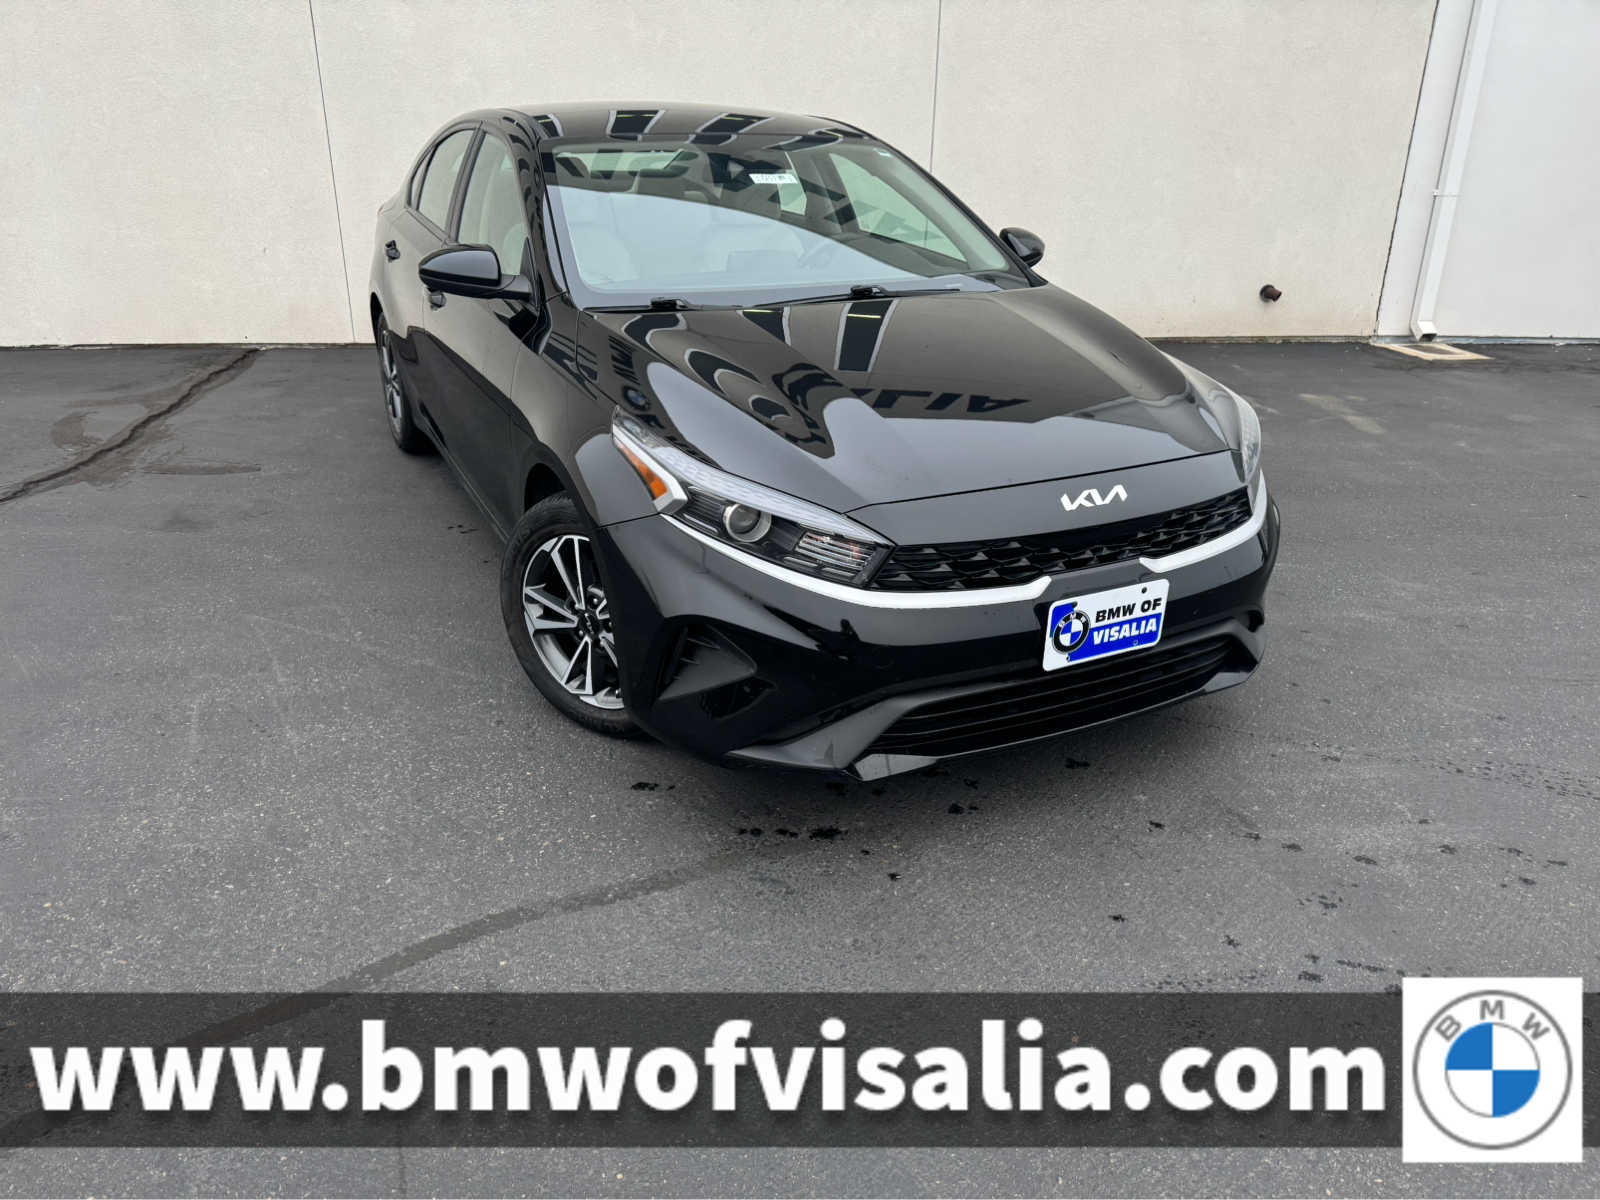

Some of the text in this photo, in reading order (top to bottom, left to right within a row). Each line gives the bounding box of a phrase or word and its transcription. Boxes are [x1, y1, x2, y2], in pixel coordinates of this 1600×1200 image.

[1060, 484, 1127, 511] KIA
[1096, 603, 1136, 623] BMW
[1141, 598, 1162, 613] OF
[1093, 618, 1157, 645] VISALIA
